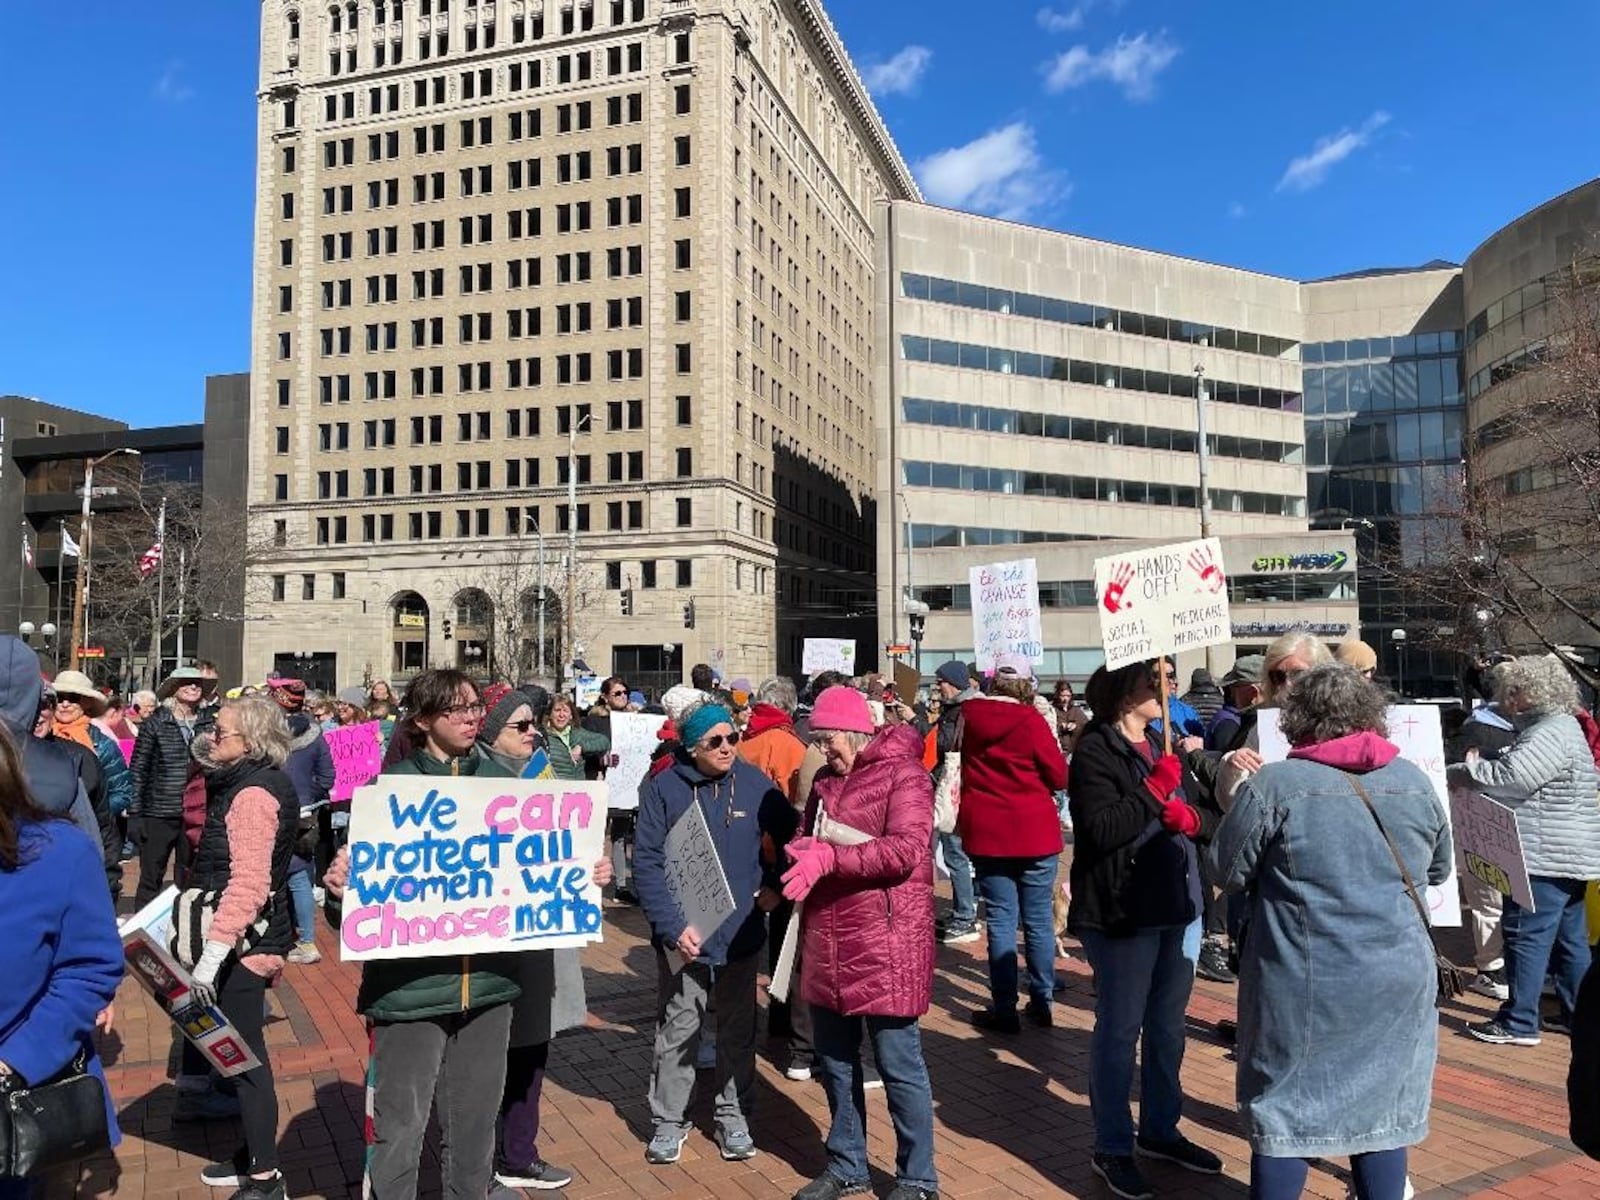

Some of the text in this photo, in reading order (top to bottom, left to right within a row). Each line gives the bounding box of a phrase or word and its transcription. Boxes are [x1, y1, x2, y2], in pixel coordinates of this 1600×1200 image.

[1137, 553, 1182, 578] HANDS
[1143, 573, 1179, 599] OFF!
[1172, 603, 1226, 627] MEDICARE
[1107, 618, 1148, 642] SOCIAL
[1173, 624, 1221, 647] MEDICAID
[1107, 638, 1153, 661] SECURITY
[389, 789, 593, 833] We can
[350, 826, 573, 888] protect all
[521, 866, 588, 896] we
[342, 888, 601, 952] Choose not to
